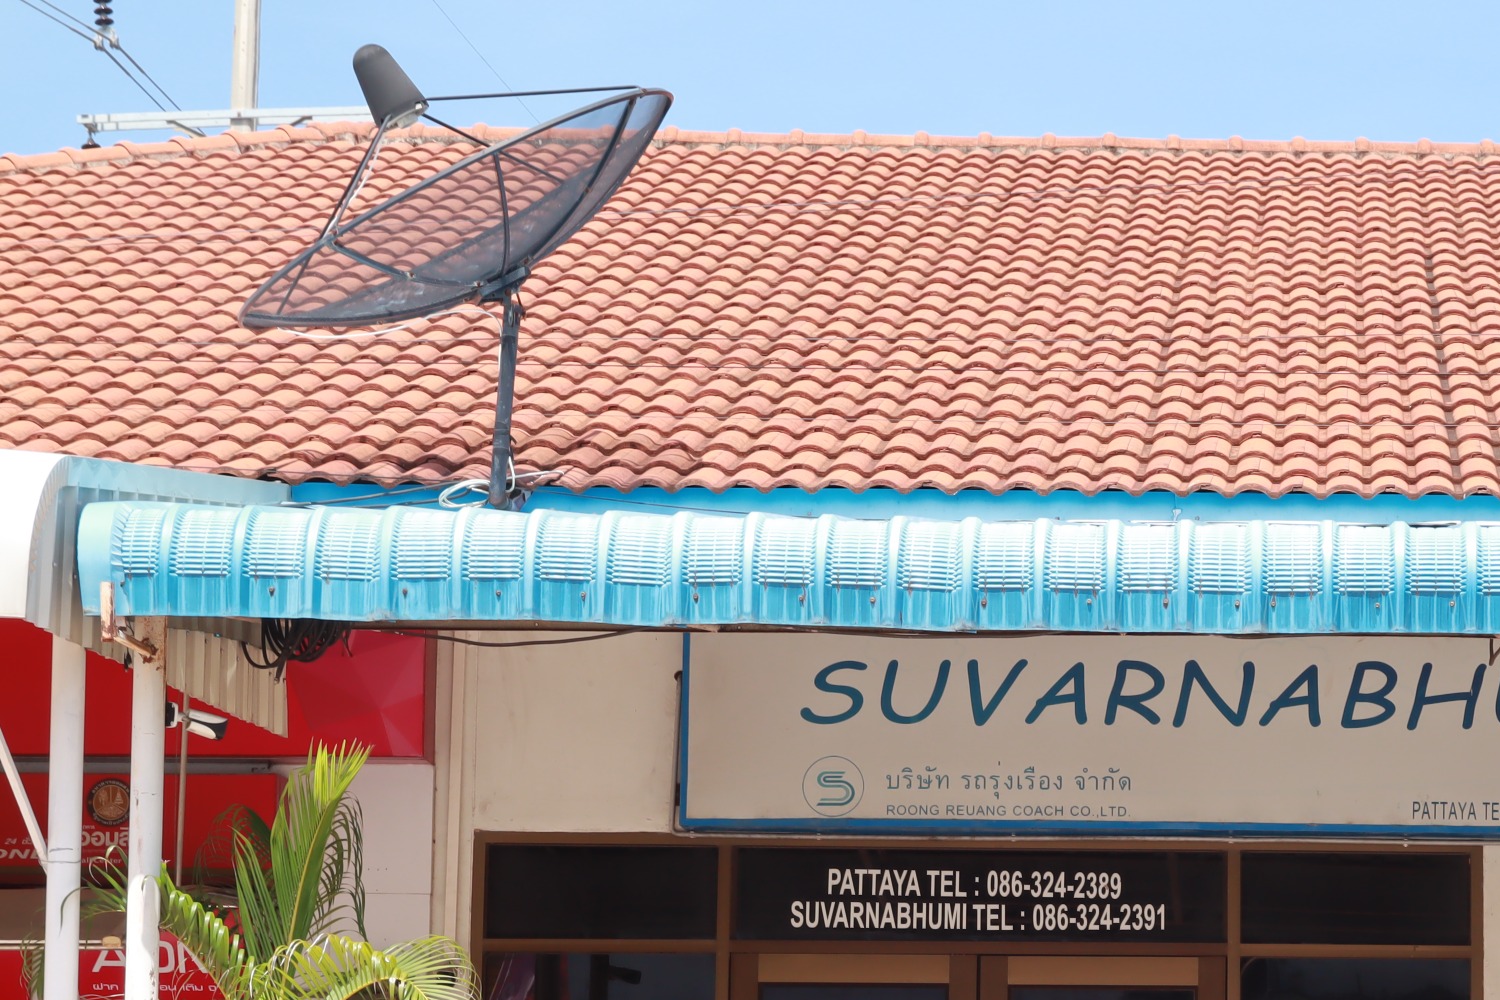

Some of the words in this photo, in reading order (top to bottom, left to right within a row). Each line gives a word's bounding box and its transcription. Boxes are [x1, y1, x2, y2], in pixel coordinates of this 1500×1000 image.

[885, 766, 950, 792] บริษัท
[1074, 767, 1132, 792] จำกัด
[886, 804, 940, 817] ROONG
[945, 804, 1007, 818] REUANG
[1012, 805, 1064, 818] COACH
[1412, 801, 1477, 821] PATTAYA
[827, 868, 921, 897] PATTAYA
[926, 869, 968, 898] TEL
[986, 871, 1122, 900] 086-324-2389
[790, 900, 968, 930] SUVARNABHUMI
[972, 903, 1014, 931] TEL
[1032, 903, 1167, 931] 086-324-2391
